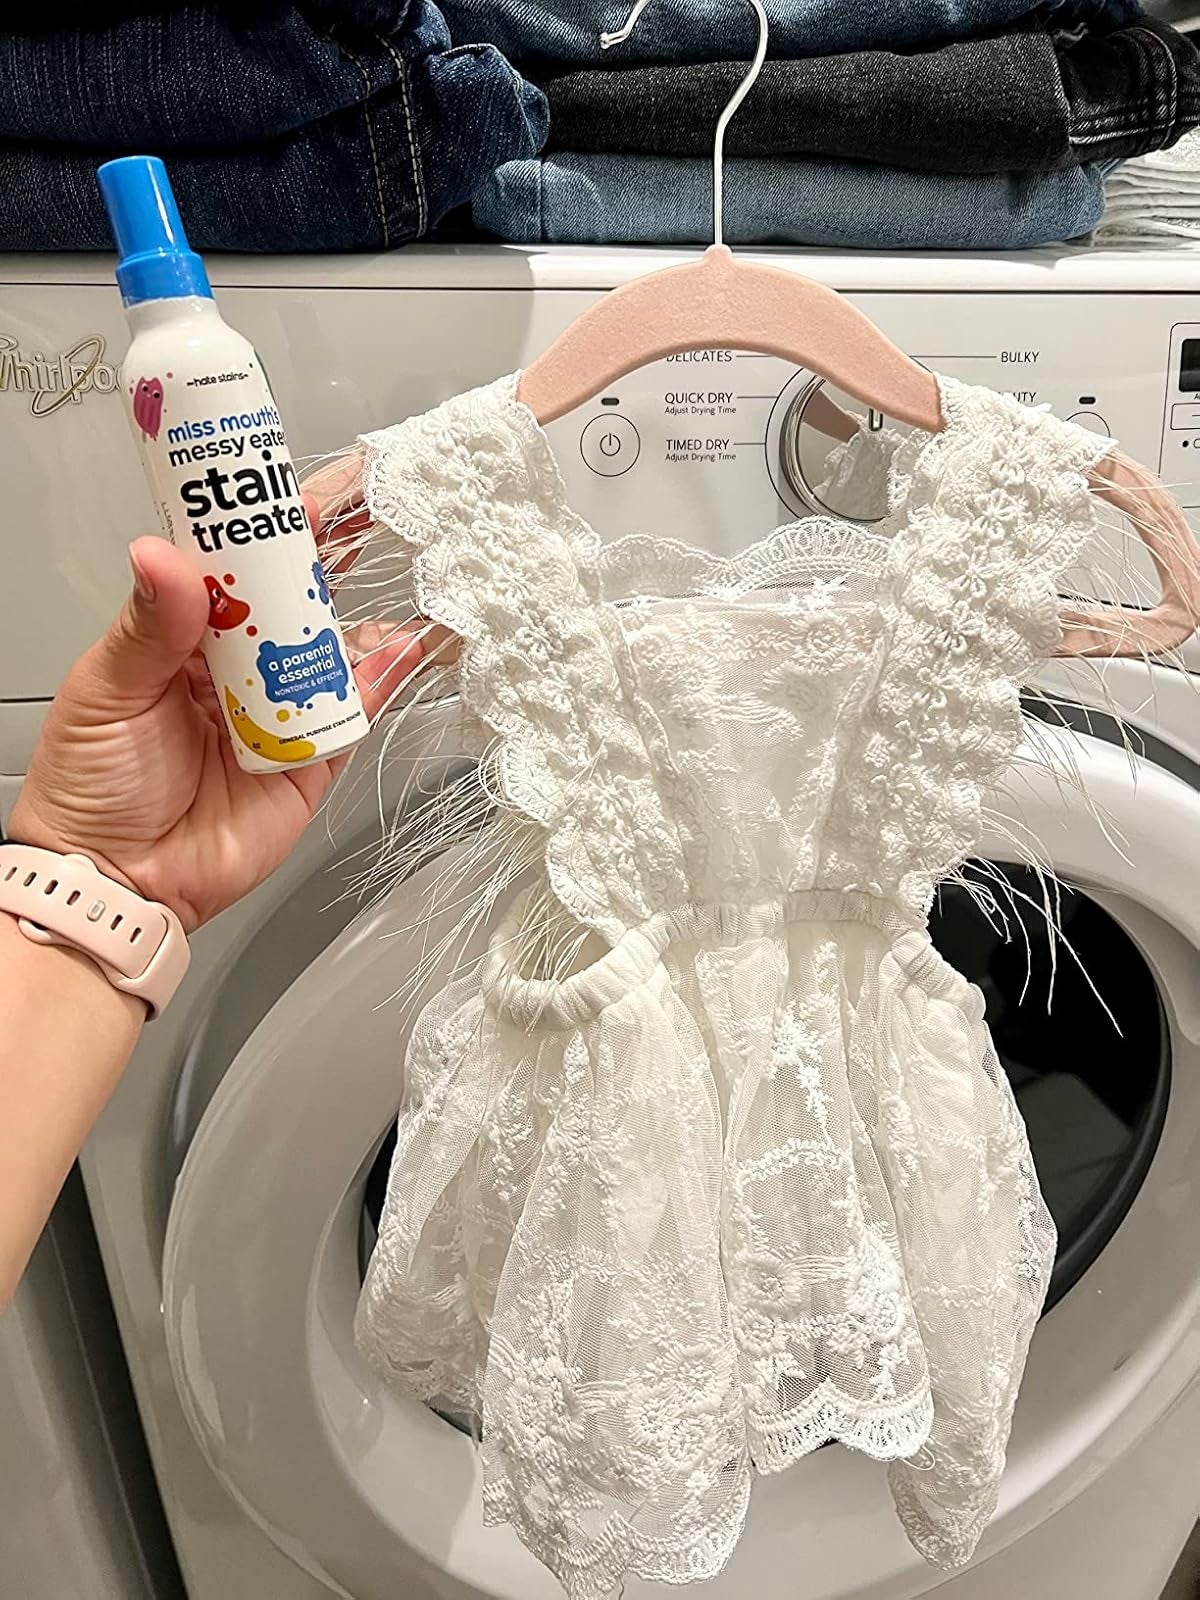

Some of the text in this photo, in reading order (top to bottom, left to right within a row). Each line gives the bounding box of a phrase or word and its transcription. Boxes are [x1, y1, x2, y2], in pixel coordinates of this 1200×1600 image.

[1000, 351, 1040, 363] BULKY
[664, 392, 733, 404] QUICK DRY
[1011, 391, 1037, 403] UTY
[664, 406, 737, 416] Adjust Drying Time
[168, 406, 279, 444] miss mouth's
[168, 428, 285, 467] messy eate
[665, 438, 730, 451] TIMED DRY
[665, 452, 737, 463] Adjust Drying Time
[180, 450, 300, 517] stain
[268, 639, 334, 672] a parental
[278, 655, 335, 684] essential
[275, 682, 310, 696] NONTOXIC
[306, 725, 332, 737] PURPOSE
